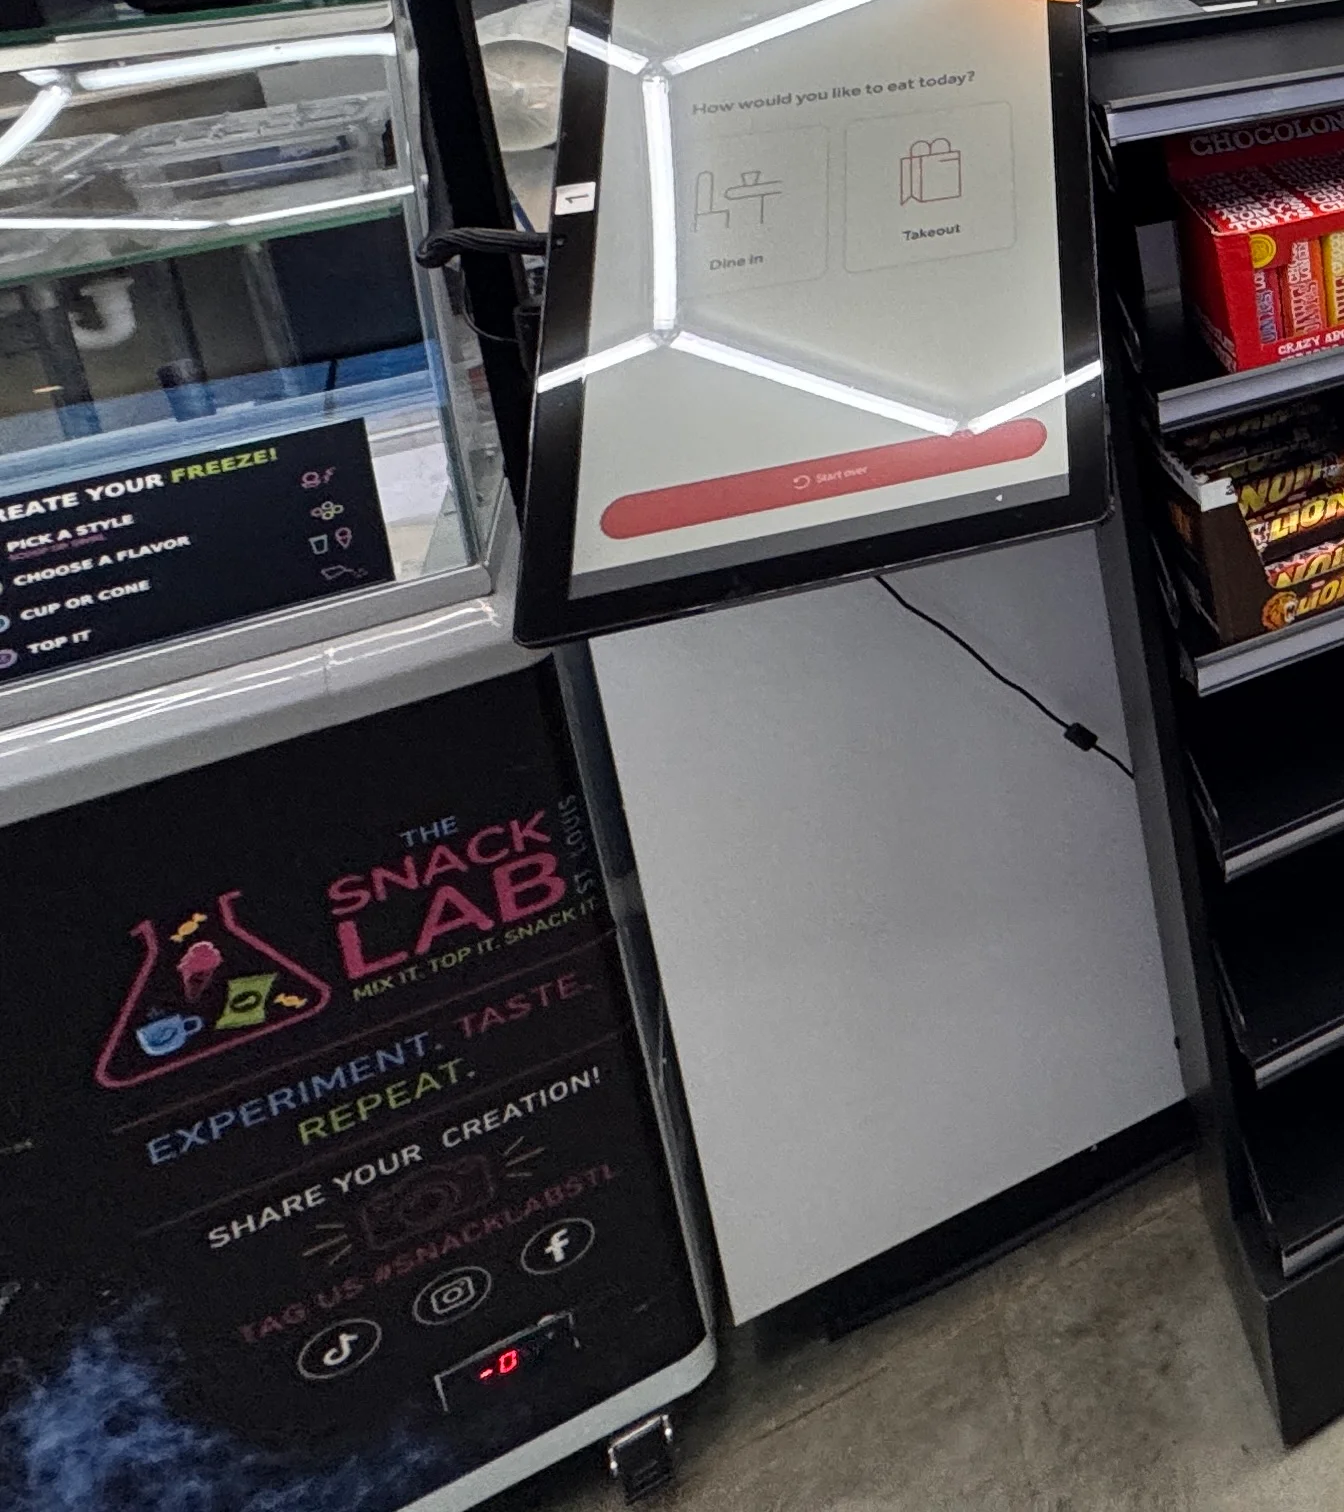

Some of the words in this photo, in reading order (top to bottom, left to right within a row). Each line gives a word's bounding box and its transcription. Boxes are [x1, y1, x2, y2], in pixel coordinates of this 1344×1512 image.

[692, 100, 734, 115] How
[737, 92, 792, 109] would
[796, 90, 828, 106] you
[832, 86, 861, 100] like
[865, 83, 883, 94] to
[886, 78, 915, 91] eat
[919, 70, 976, 89] today?
[902, 223, 961, 241] Takeout
[1227, 207, 1314, 232] TONY'S
[709, 256, 746, 271] Dine
[749, 253, 764, 265] in
[1277, 337, 1321, 356] CRAZY
[85, 473, 164, 502] YOUR
[171, 447, 279, 484] FREEZE!
[816, 469, 842, 484] Start
[843, 466, 868, 478] over
[7, 532, 52, 553] PICK
[57, 528, 73, 541] A
[76, 513, 135, 537] STYLE
[13, 558, 94, 587] CHOOSE
[98, 554, 114, 567] A
[116, 535, 191, 563] FLAVOR
[20, 602, 61, 621] CUP
[64, 594, 94, 610] OR
[97, 579, 152, 601] CONE
[27, 637, 71, 655] TOP
[73, 629, 92, 644] IT
[400, 815, 458, 848] THE
[328, 809, 552, 916] SNACK
[338, 851, 567, 979] LAB
[353, 974, 394, 1002] MIX
[400, 965, 426, 984] IT.
[428, 946, 471, 973] TOP
[478, 937, 500, 955] IT.
[505, 908, 576, 946] SNACK
[148, 1031, 445, 1166] EXPERIMENT.
[456, 972, 596, 1038] TASTE.
[298, 1057, 478, 1145] REPEAT.
[208, 1185, 326, 1249] SHARE
[333, 1143, 423, 1194] YOUR
[441, 1066, 601, 1149] CREATION!
[241, 1306, 306, 1343] TAG
[318, 1277, 365, 1308] US
[374, 1163, 615, 1285] #SNACKLABSTL
